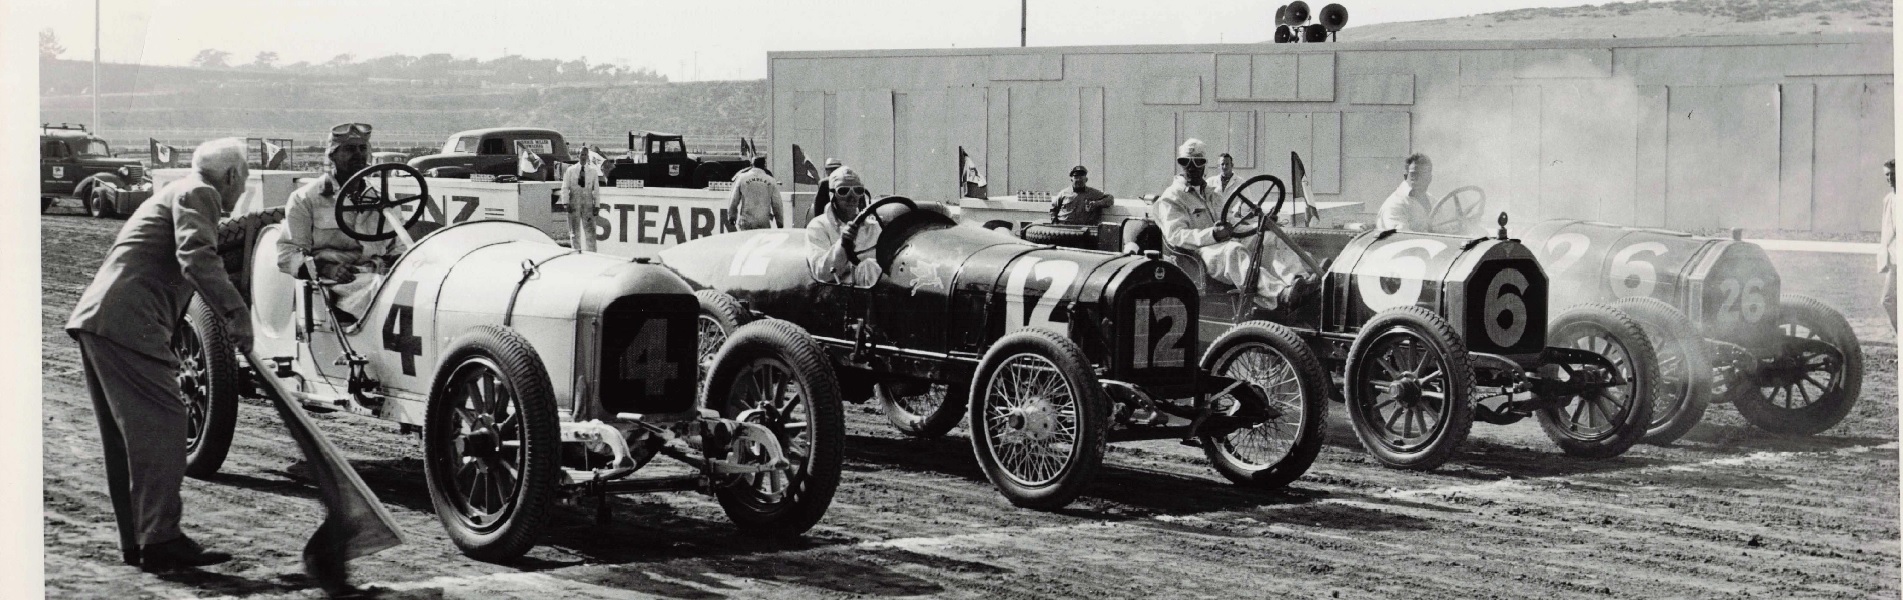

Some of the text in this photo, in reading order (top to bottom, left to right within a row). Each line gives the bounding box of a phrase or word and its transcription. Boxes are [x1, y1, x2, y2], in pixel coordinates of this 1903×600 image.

[728, 232, 790, 276] 12
[1357, 238, 1448, 315] 6
[1547, 232, 1669, 301] 26
[383, 280, 422, 377] 4
[1005, 256, 1080, 336] 12
[1133, 296, 1188, 369] 12
[1483, 267, 1530, 348] 6
[1716, 277, 1767, 324] 26
[619, 318, 679, 396] 4
